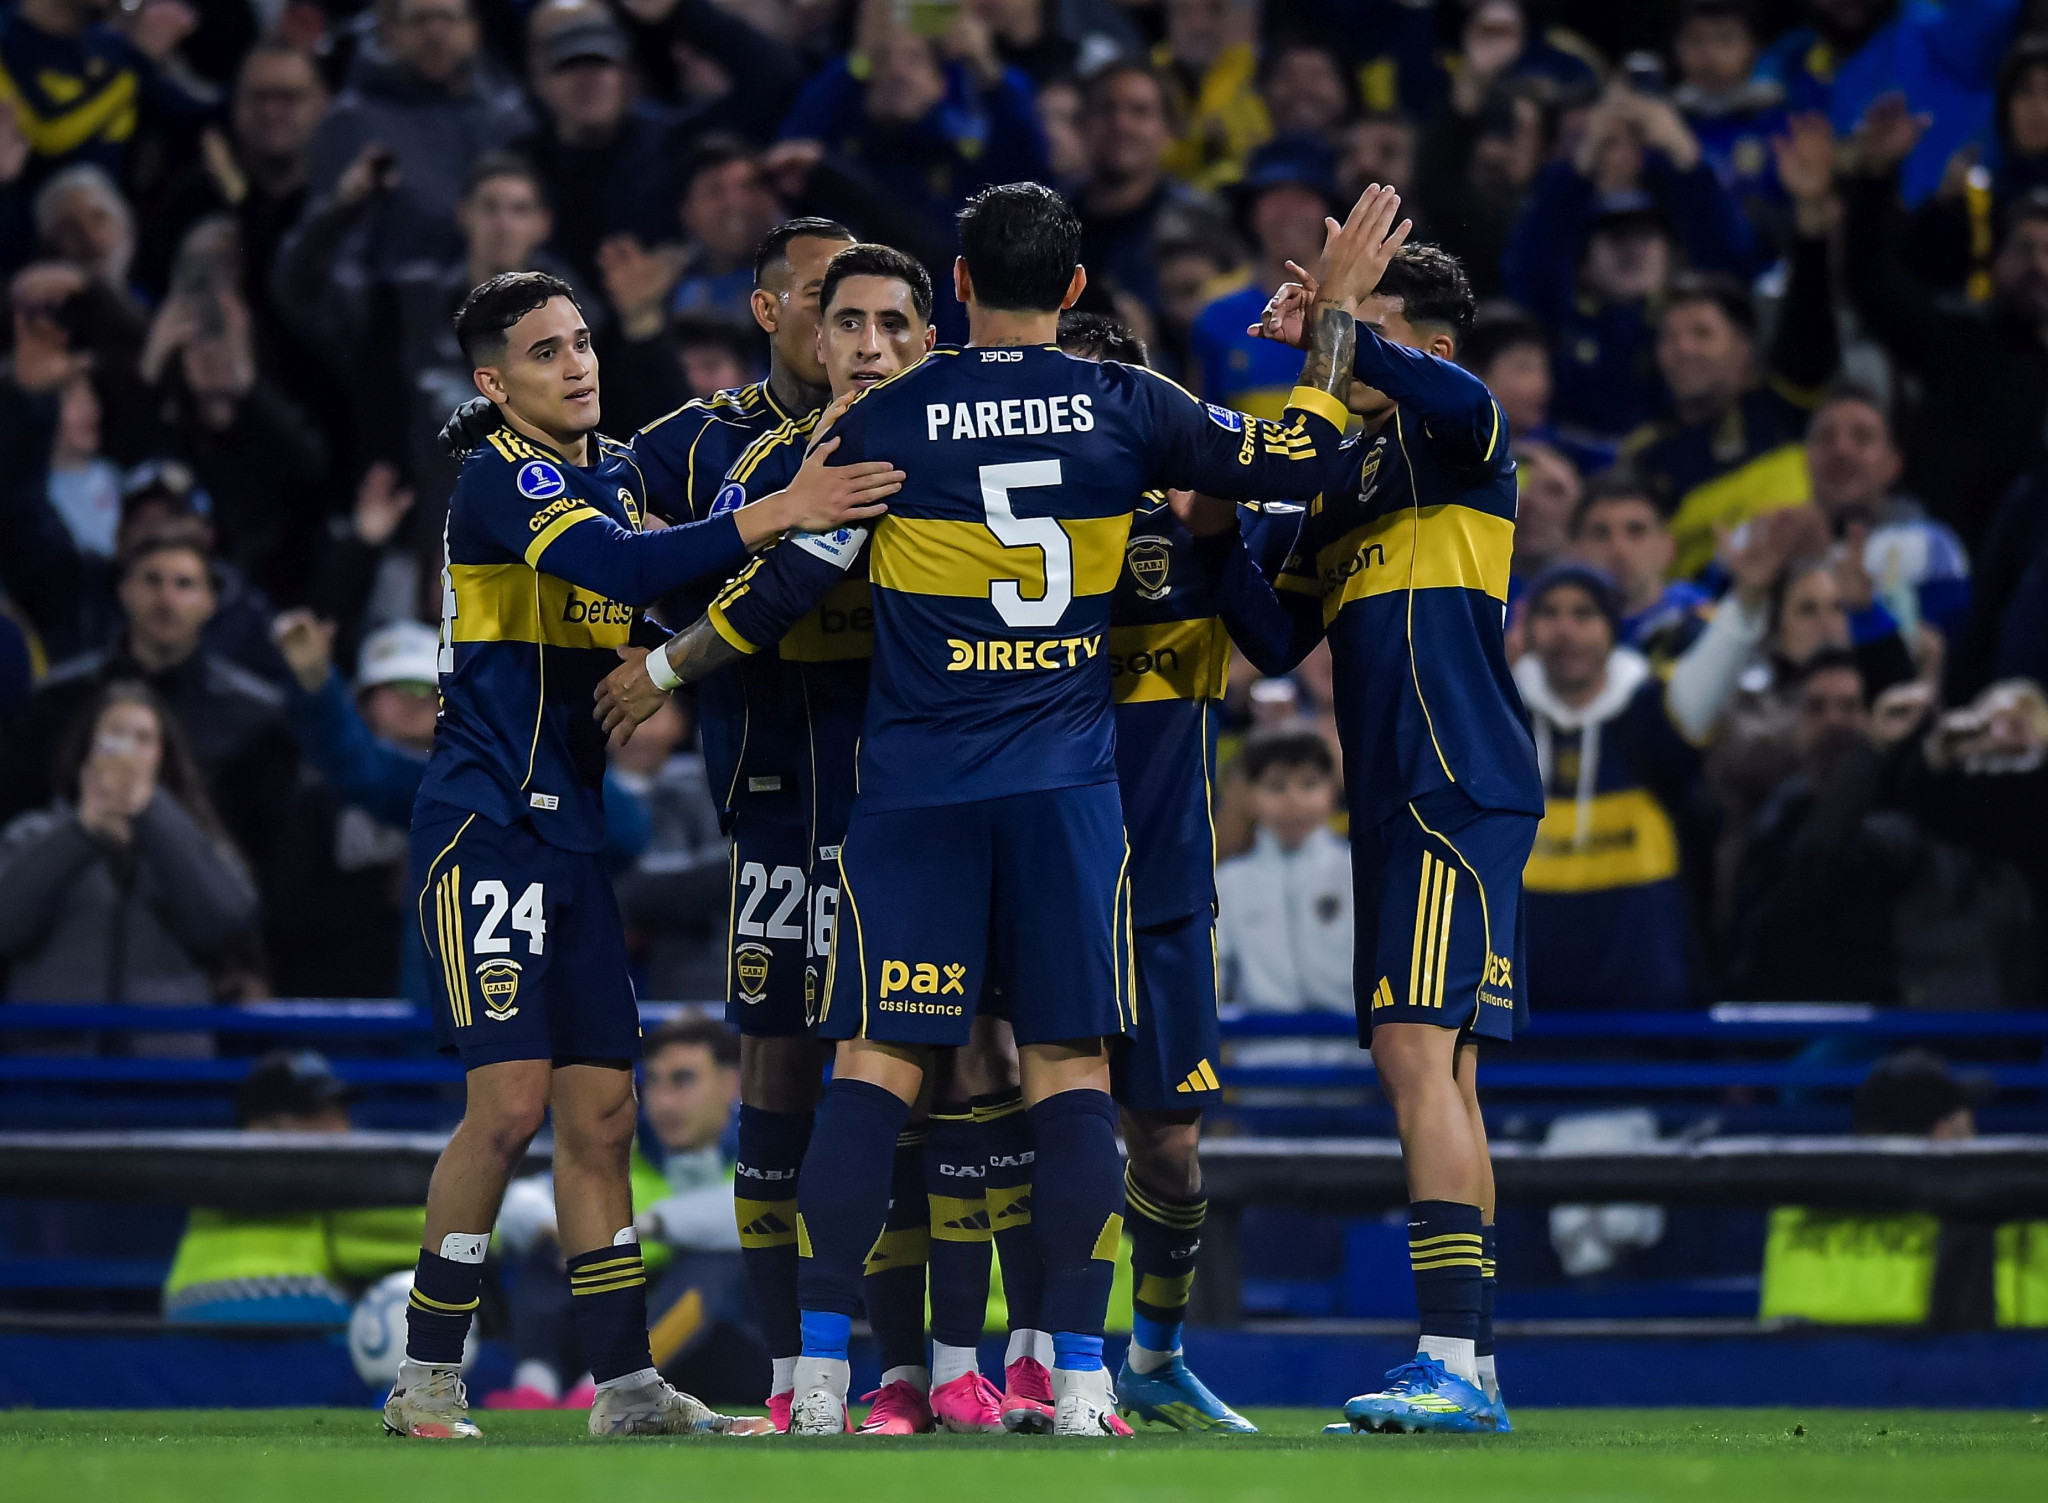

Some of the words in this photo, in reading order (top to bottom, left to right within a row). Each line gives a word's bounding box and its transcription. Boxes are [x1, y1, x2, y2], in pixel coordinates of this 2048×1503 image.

[926, 393, 1095, 441] PAREDES
[978, 458, 1072, 628] 5
[1136, 560, 1163, 571] CABJ
[946, 634, 1102, 671] DIRECTV
[471, 880, 546, 955] 24
[737, 861, 806, 940] 22
[487, 983, 512, 993] CABJ
[742, 967, 764, 977] CABJ
[880, 960, 966, 998] pax
[879, 1000, 963, 1016] assistance
[736, 1161, 796, 1180] CABJ
